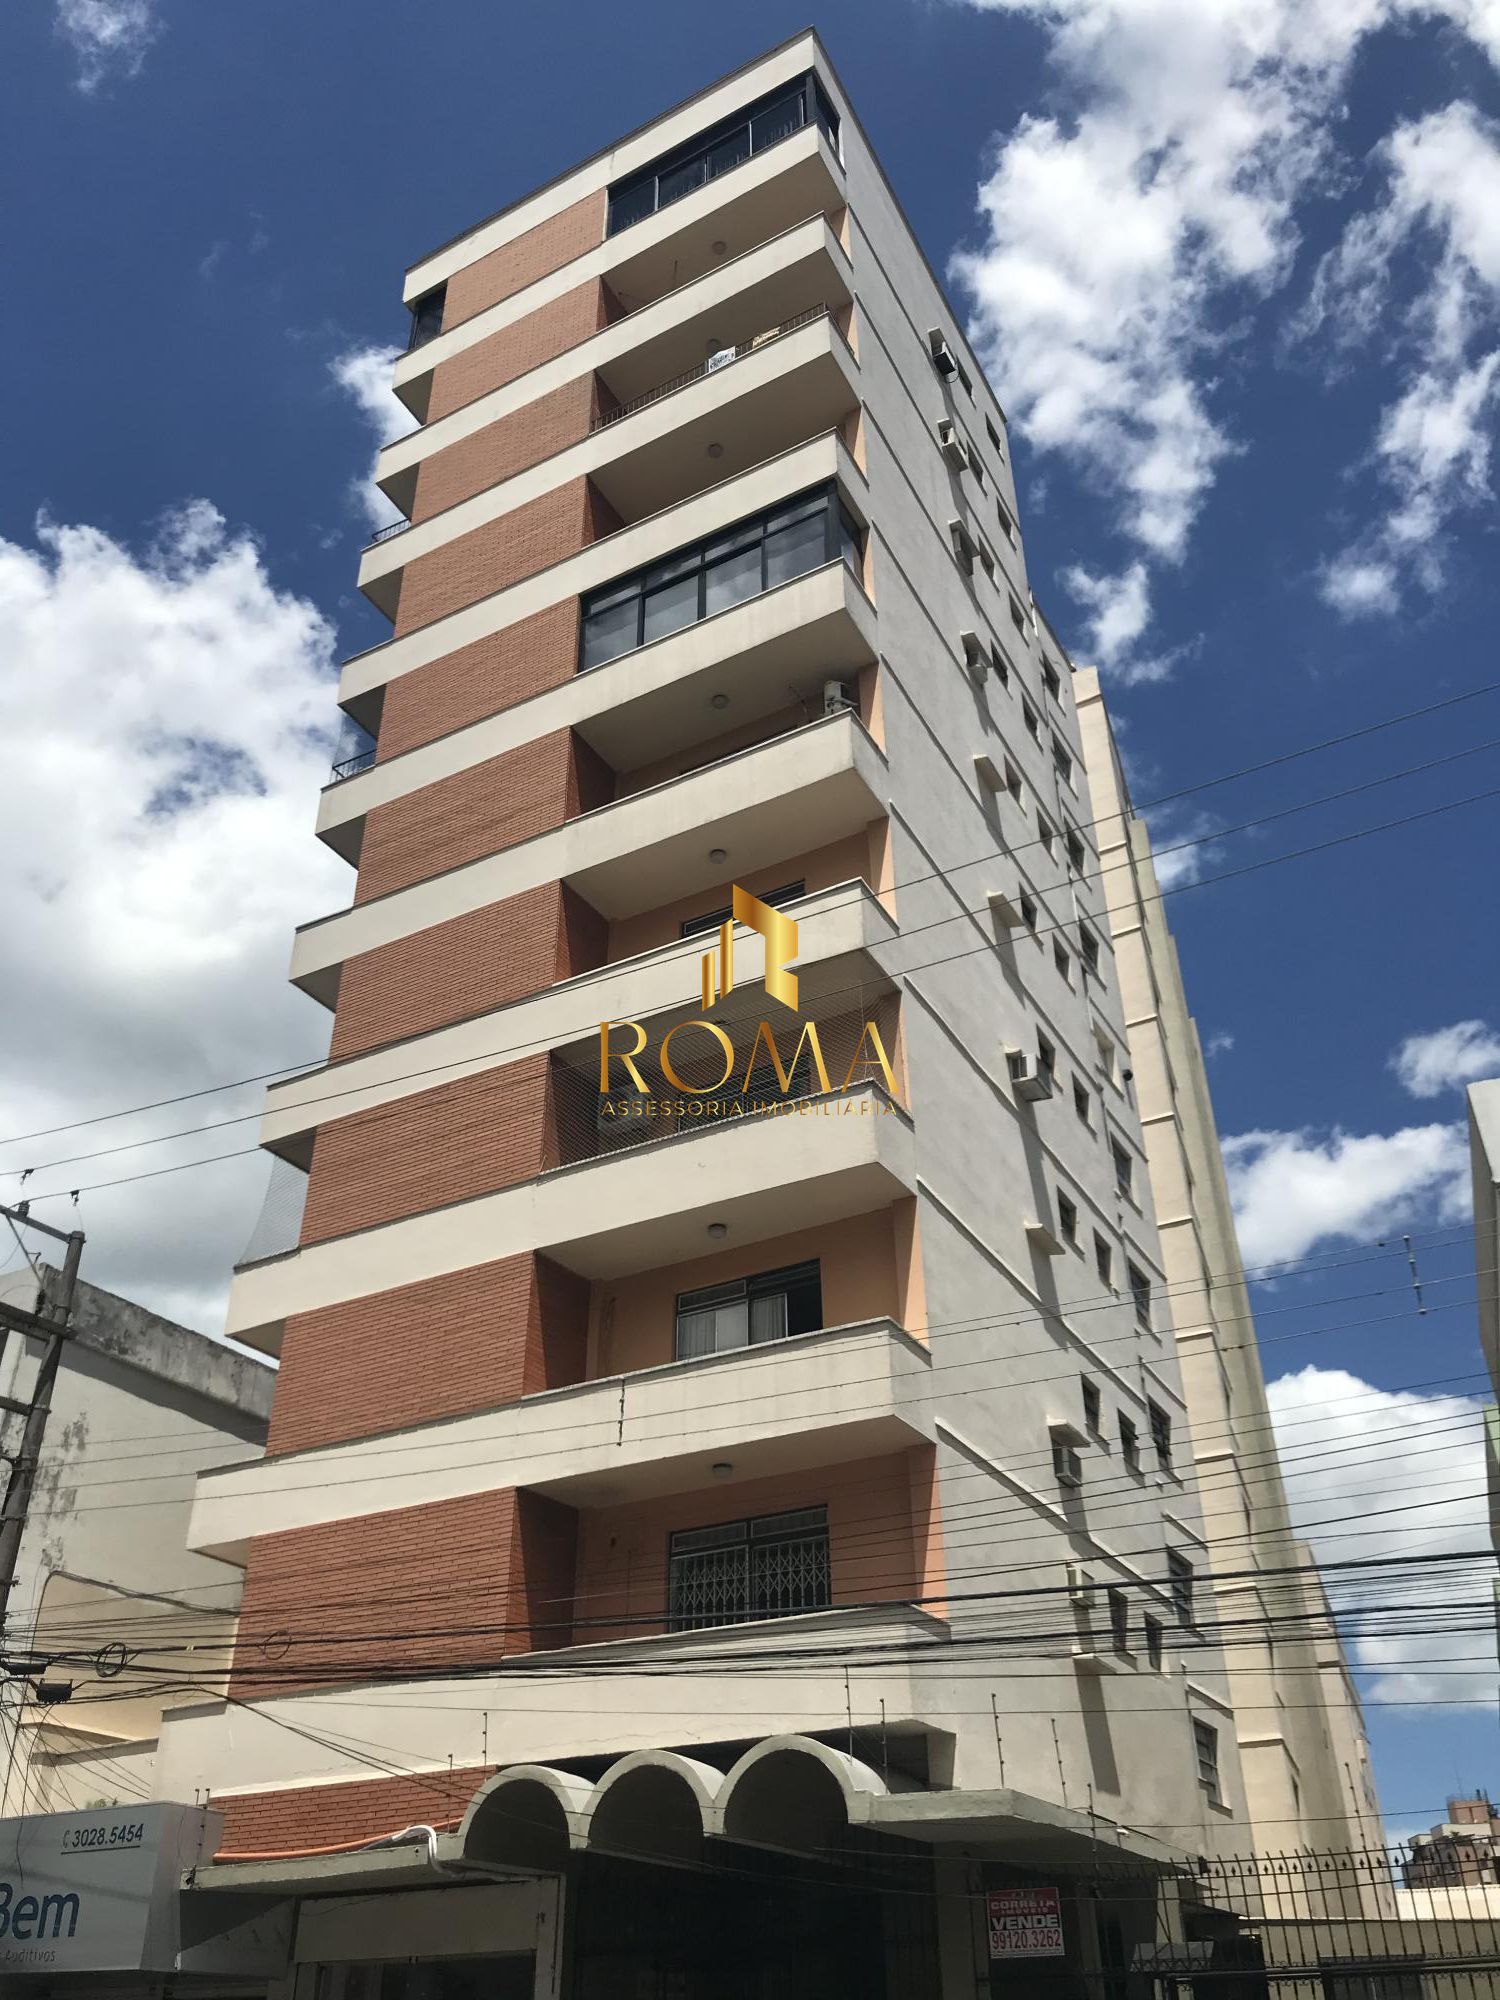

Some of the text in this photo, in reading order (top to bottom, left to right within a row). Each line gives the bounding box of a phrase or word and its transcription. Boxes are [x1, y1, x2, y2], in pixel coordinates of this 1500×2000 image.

[72, 1823, 144, 1847] 3028.5454
[992, 1914, 1058, 1930] VENDE
[992, 1929, 1061, 1950] 99120.3262
